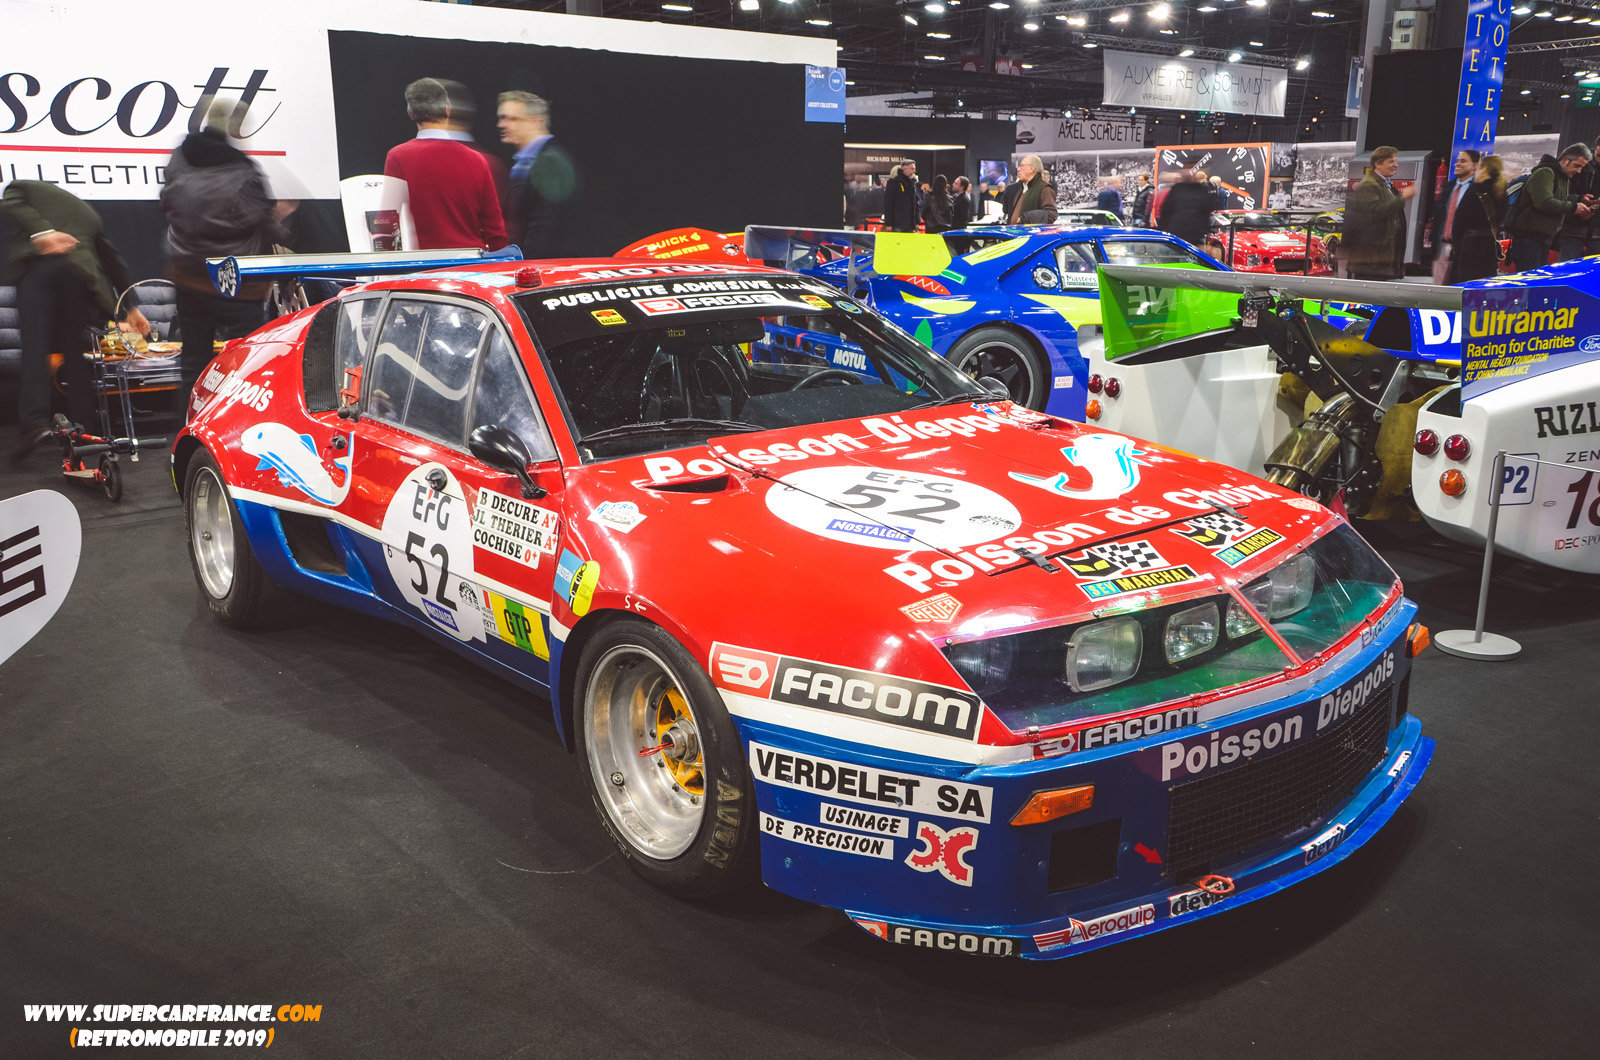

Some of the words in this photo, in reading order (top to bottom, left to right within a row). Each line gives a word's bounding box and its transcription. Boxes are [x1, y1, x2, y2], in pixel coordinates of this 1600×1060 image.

[1123, 65, 1194, 89] AUXIETRE
[1196, 67, 1211, 95] &
[1213, 73, 1271, 95] SCHMIDT
[1058, 121, 1085, 139] AXEL
[1090, 123, 1142, 142] SCHUETTE
[578, 264, 728, 280] MOTUL
[1066, 275, 1097, 283] Masters
[543, 284, 669, 312] PUBLICITE
[672, 279, 775, 295] ADHESIVE
[683, 292, 778, 309] FACOM
[1469, 307, 1579, 338] Ultramar
[832, 348, 867, 371] MOTUL
[1465, 360, 1490, 371] MENTAL
[1490, 356, 1512, 368] HEALTH
[1512, 352, 1550, 366] FOUNDATION
[1467, 342, 1506, 358] Racing
[1509, 338, 1526, 354] for
[1527, 334, 1576, 351] Charities
[1464, 373, 1475, 382] ST.
[1474, 368, 1496, 380] JOHNS
[1494, 364, 1531, 378] AMBULANCE
[643, 428, 859, 485] Poisson
[865, 471, 955, 494] EFG
[1499, 465, 1530, 494] P2
[412, 484, 452, 531] EFG
[480, 491, 488, 506] B
[491, 495, 540, 525] DECURE
[541, 513, 556, 529] A+
[824, 484, 961, 524] 52
[473, 508, 486, 526] JL
[491, 515, 542, 546] THERIER
[831, 521, 911, 541] NOSTALGIE
[882, 523, 1106, 594] Poisson
[1104, 505, 1171, 526] de
[1162, 484, 1283, 510] Choix
[474, 528, 523, 560] COCHISE
[1220, 548, 1243, 563] SEV
[1234, 529, 1283, 556] MARCHAL
[1554, 537, 1580, 551] IDEC
[405, 531, 459, 612] 52
[1087, 581, 1117, 596] SEV
[1115, 568, 1195, 592] MARCHAL
[911, 599, 957, 619] HEUER
[503, 608, 532, 642] GTP
[780, 667, 972, 731] FACOM
[1084, 707, 1194, 749] FACOM
[1161, 712, 1303, 782] Poisson
[1316, 652, 1395, 731] Dieppois
[755, 747, 921, 806] VERDELET
[937, 785, 986, 818] SA
[703, 780, 743, 870] AVON
[824, 806, 902, 834] USINAGE
[765, 816, 785, 836] DE
[792, 820, 885, 856] PRECISION
[1069, 905, 1155, 942] Aeroquip
[894, 927, 1014, 957] FACOM
